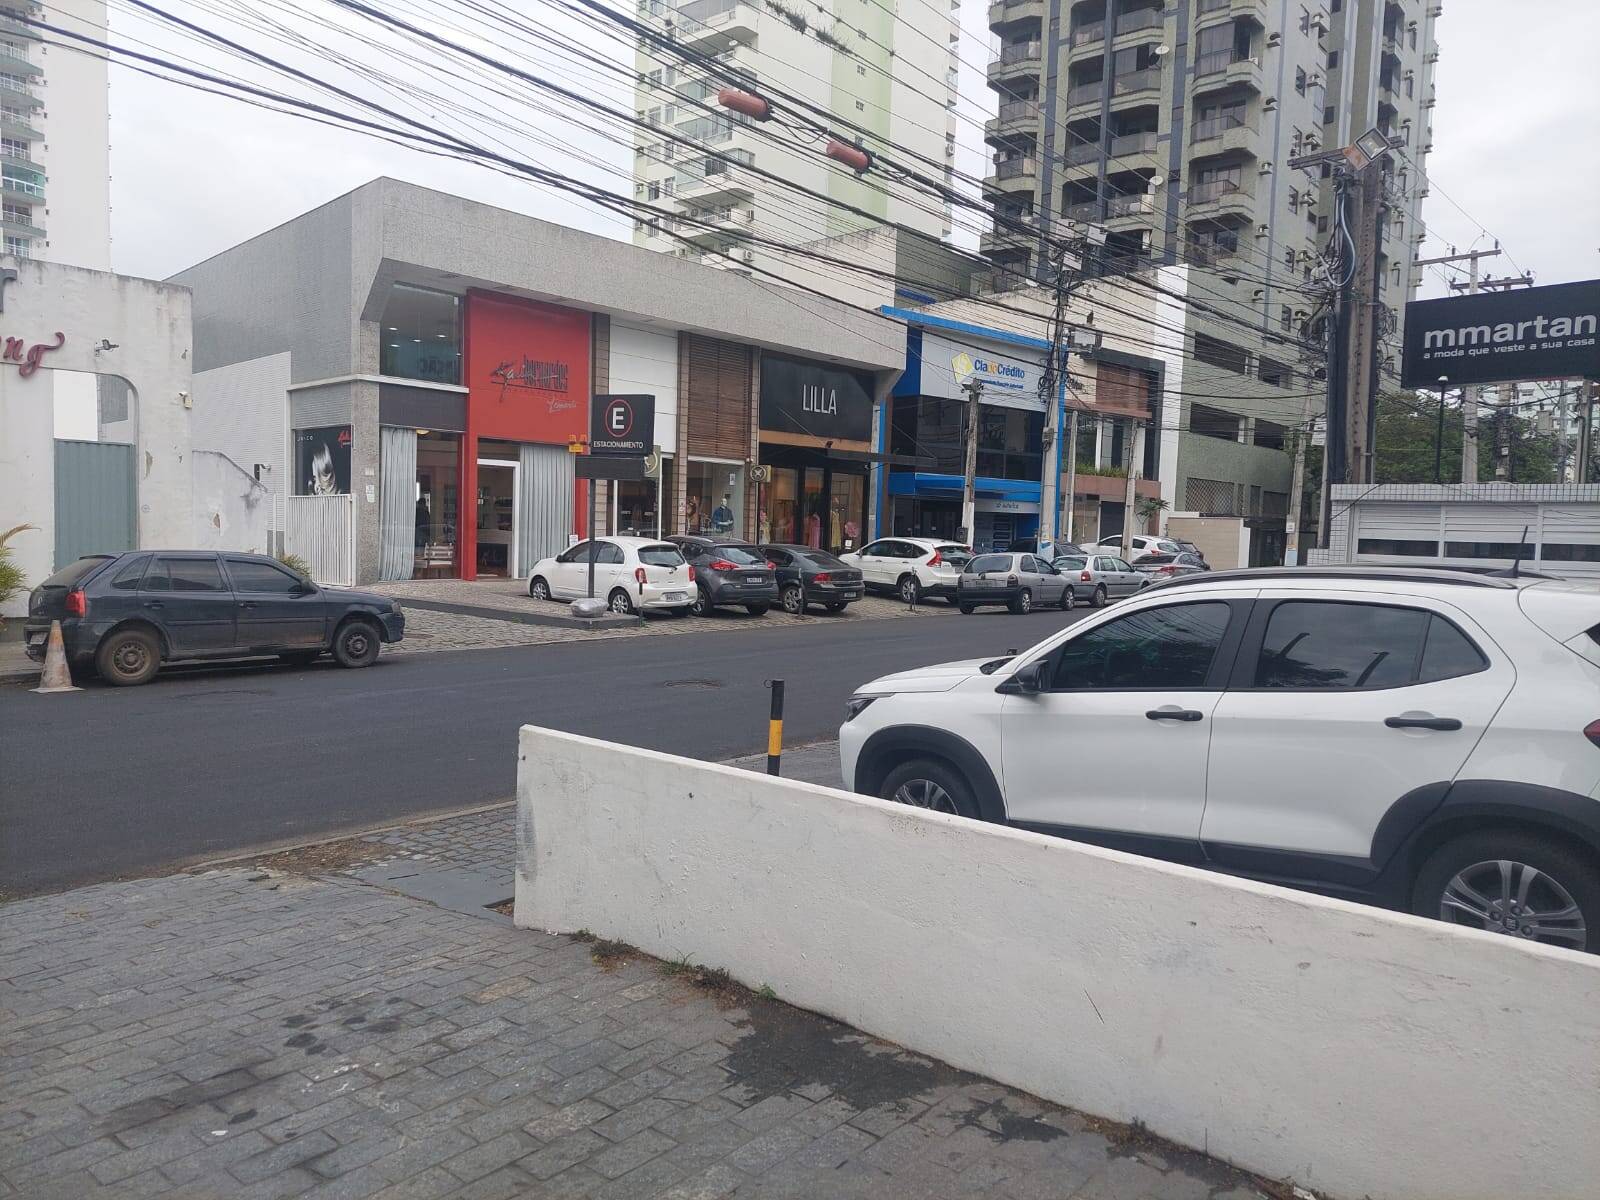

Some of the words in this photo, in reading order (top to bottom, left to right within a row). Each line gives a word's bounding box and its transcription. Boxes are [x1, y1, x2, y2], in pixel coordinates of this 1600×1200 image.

[1424, 314, 1597, 348] mmartan
[0, 331, 65, 377] ng
[1434, 349, 1464, 358] moda
[1468, 347, 1489, 357] que
[1494, 343, 1525, 352] veste
[1541, 341, 1563, 349] sua
[1567, 338, 1595, 346] casa
[803, 384, 837, 415] LILLA
[612, 407, 625, 429] E
[593, 440, 644, 449] ESTACIONAMENTO
